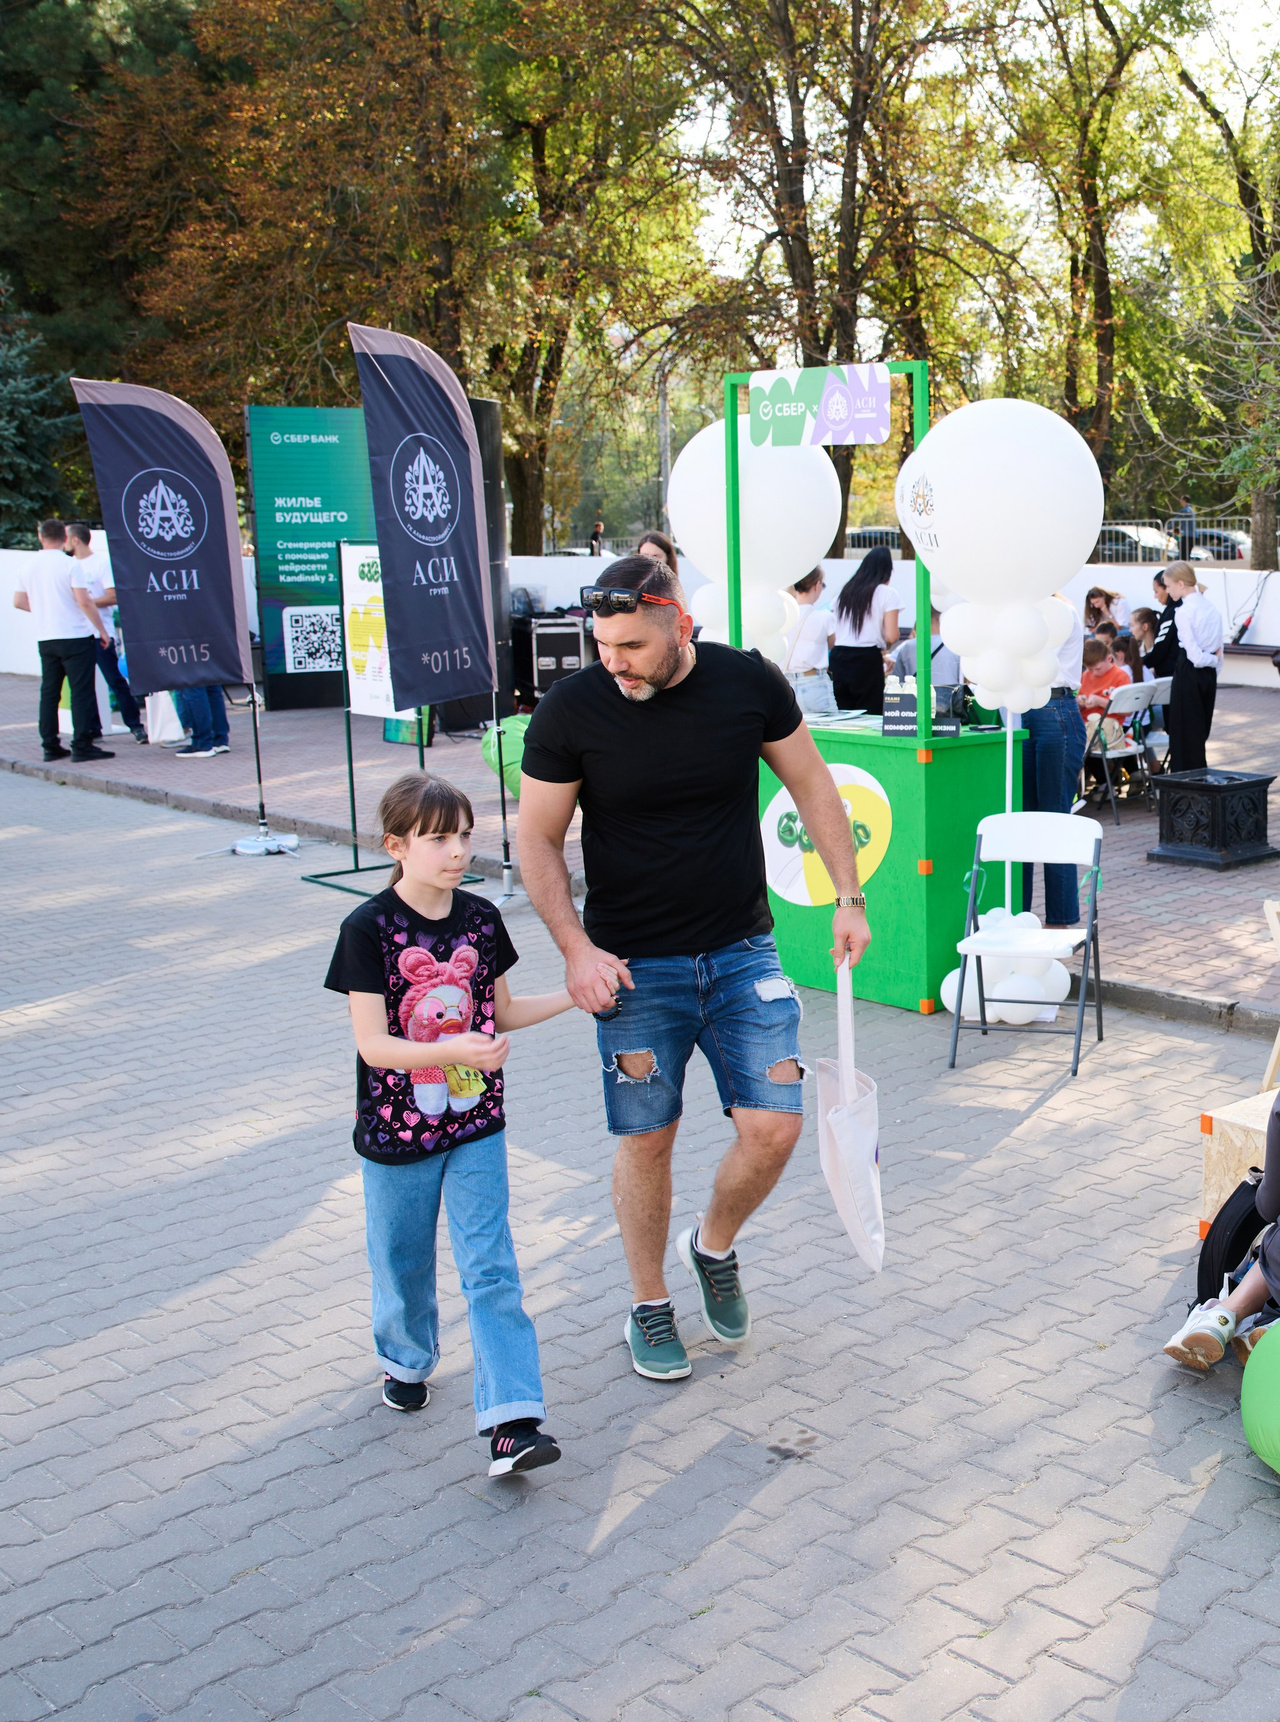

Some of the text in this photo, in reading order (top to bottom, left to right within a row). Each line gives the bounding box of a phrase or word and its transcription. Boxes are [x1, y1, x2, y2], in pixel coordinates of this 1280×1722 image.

[775, 402, 805, 416] СБЕР
[855, 397, 876, 409] АСИ
[274, 497, 322, 508] ЖИЛЬЕ
[275, 511, 348, 524] БУДУЩЕГО
[276, 540, 337, 550] Сгенерирова
[278, 562, 327, 573] нейросети
[412, 556, 459, 586] АСИ
[146, 569, 200, 593] АСИ
[279, 573, 326, 584] Kandinsky
[429, 587, 449, 596] ГРУПП
